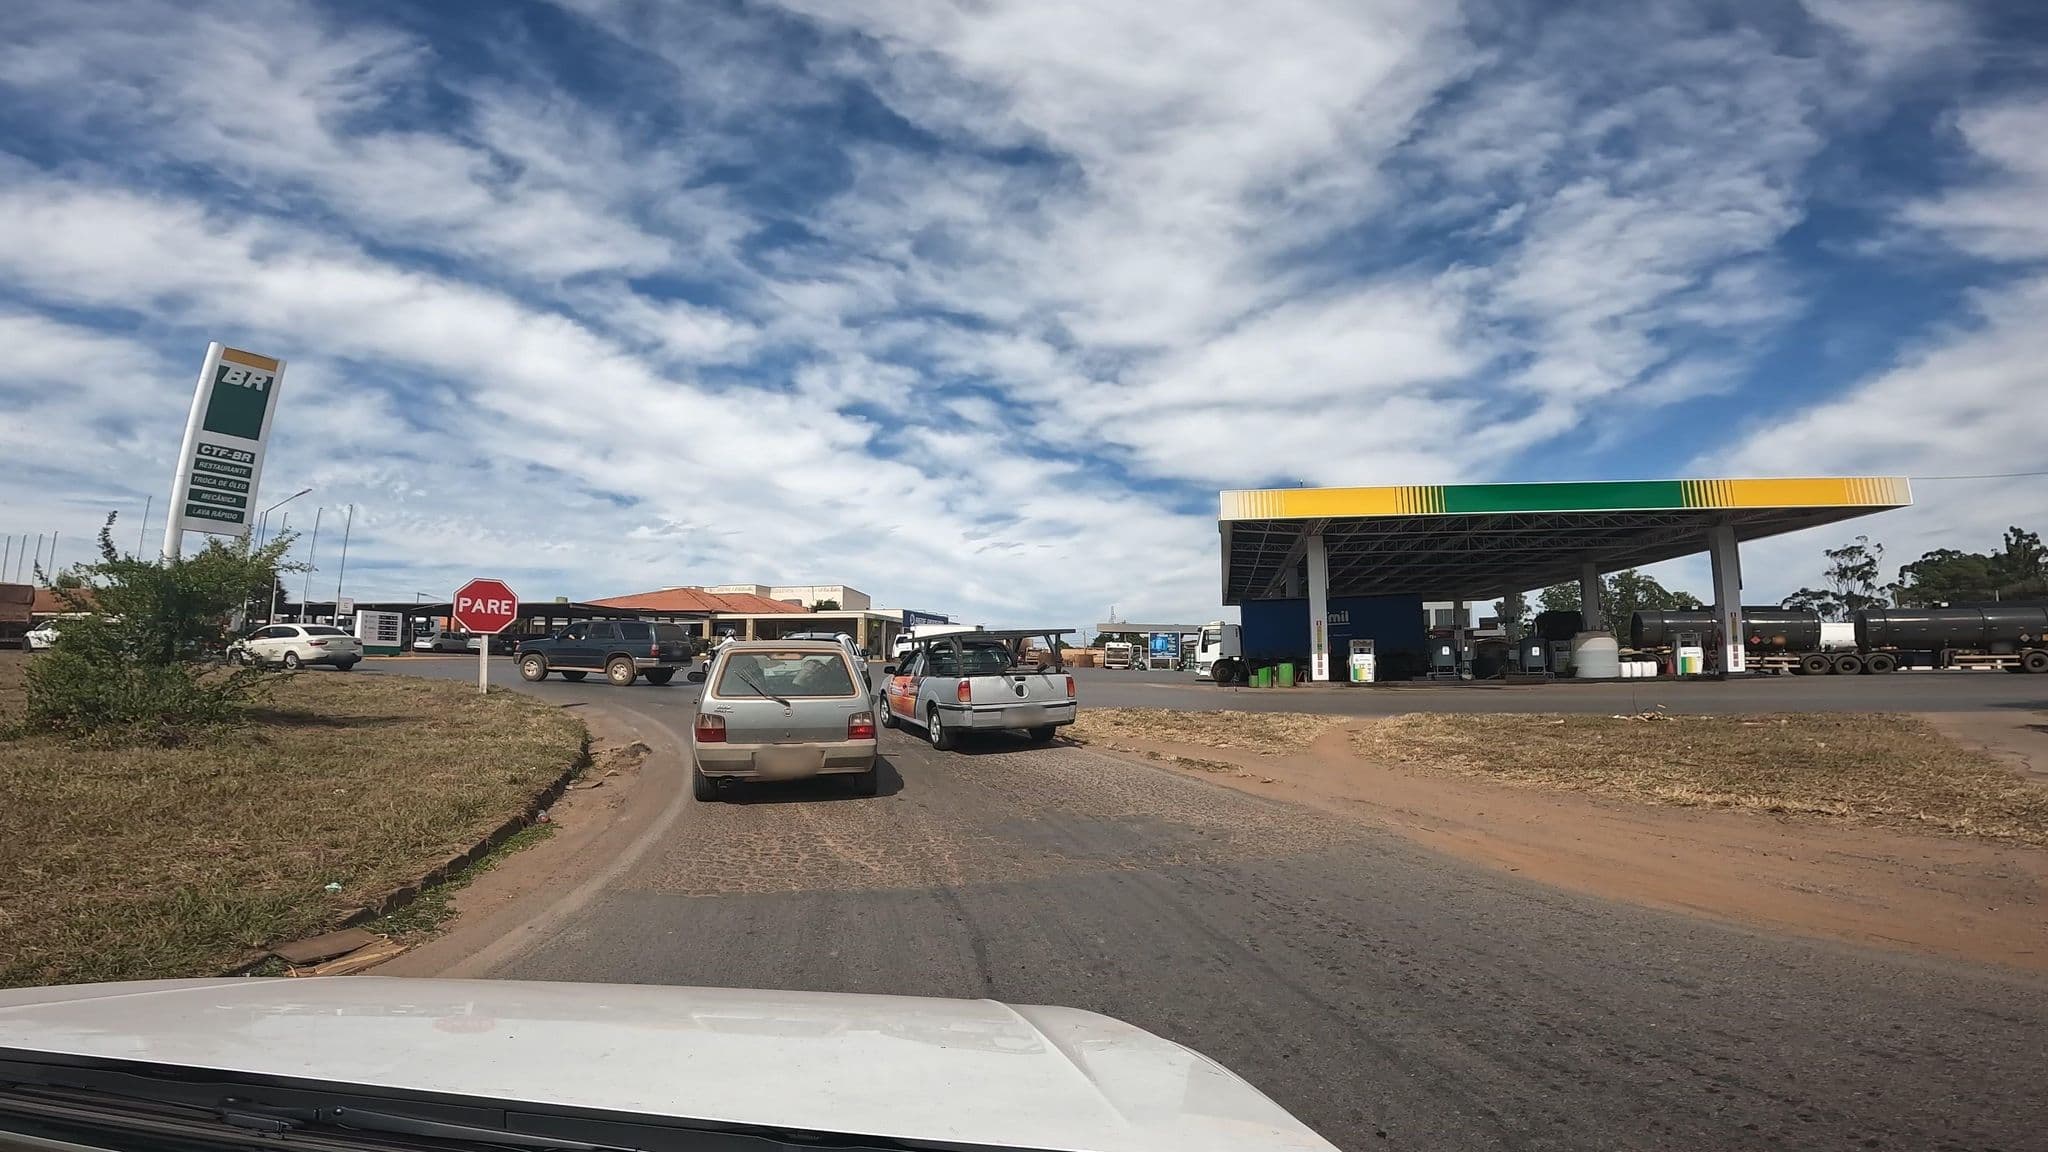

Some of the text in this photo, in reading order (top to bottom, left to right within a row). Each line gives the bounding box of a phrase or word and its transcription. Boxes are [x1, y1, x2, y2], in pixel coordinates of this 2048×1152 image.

[221, 365, 268, 391] BR
[201, 446, 252, 462] CTF-BR
[198, 461, 248, 475] RESTAURANTE
[193, 476, 217, 486] TROCA
[217, 479, 227, 487] DE
[200, 492, 237, 504] MECÂNICA
[192, 508, 238, 520] LAVA RÁPIDO
[458, 597, 513, 615] PARE
[1327, 610, 1349, 622] mil
